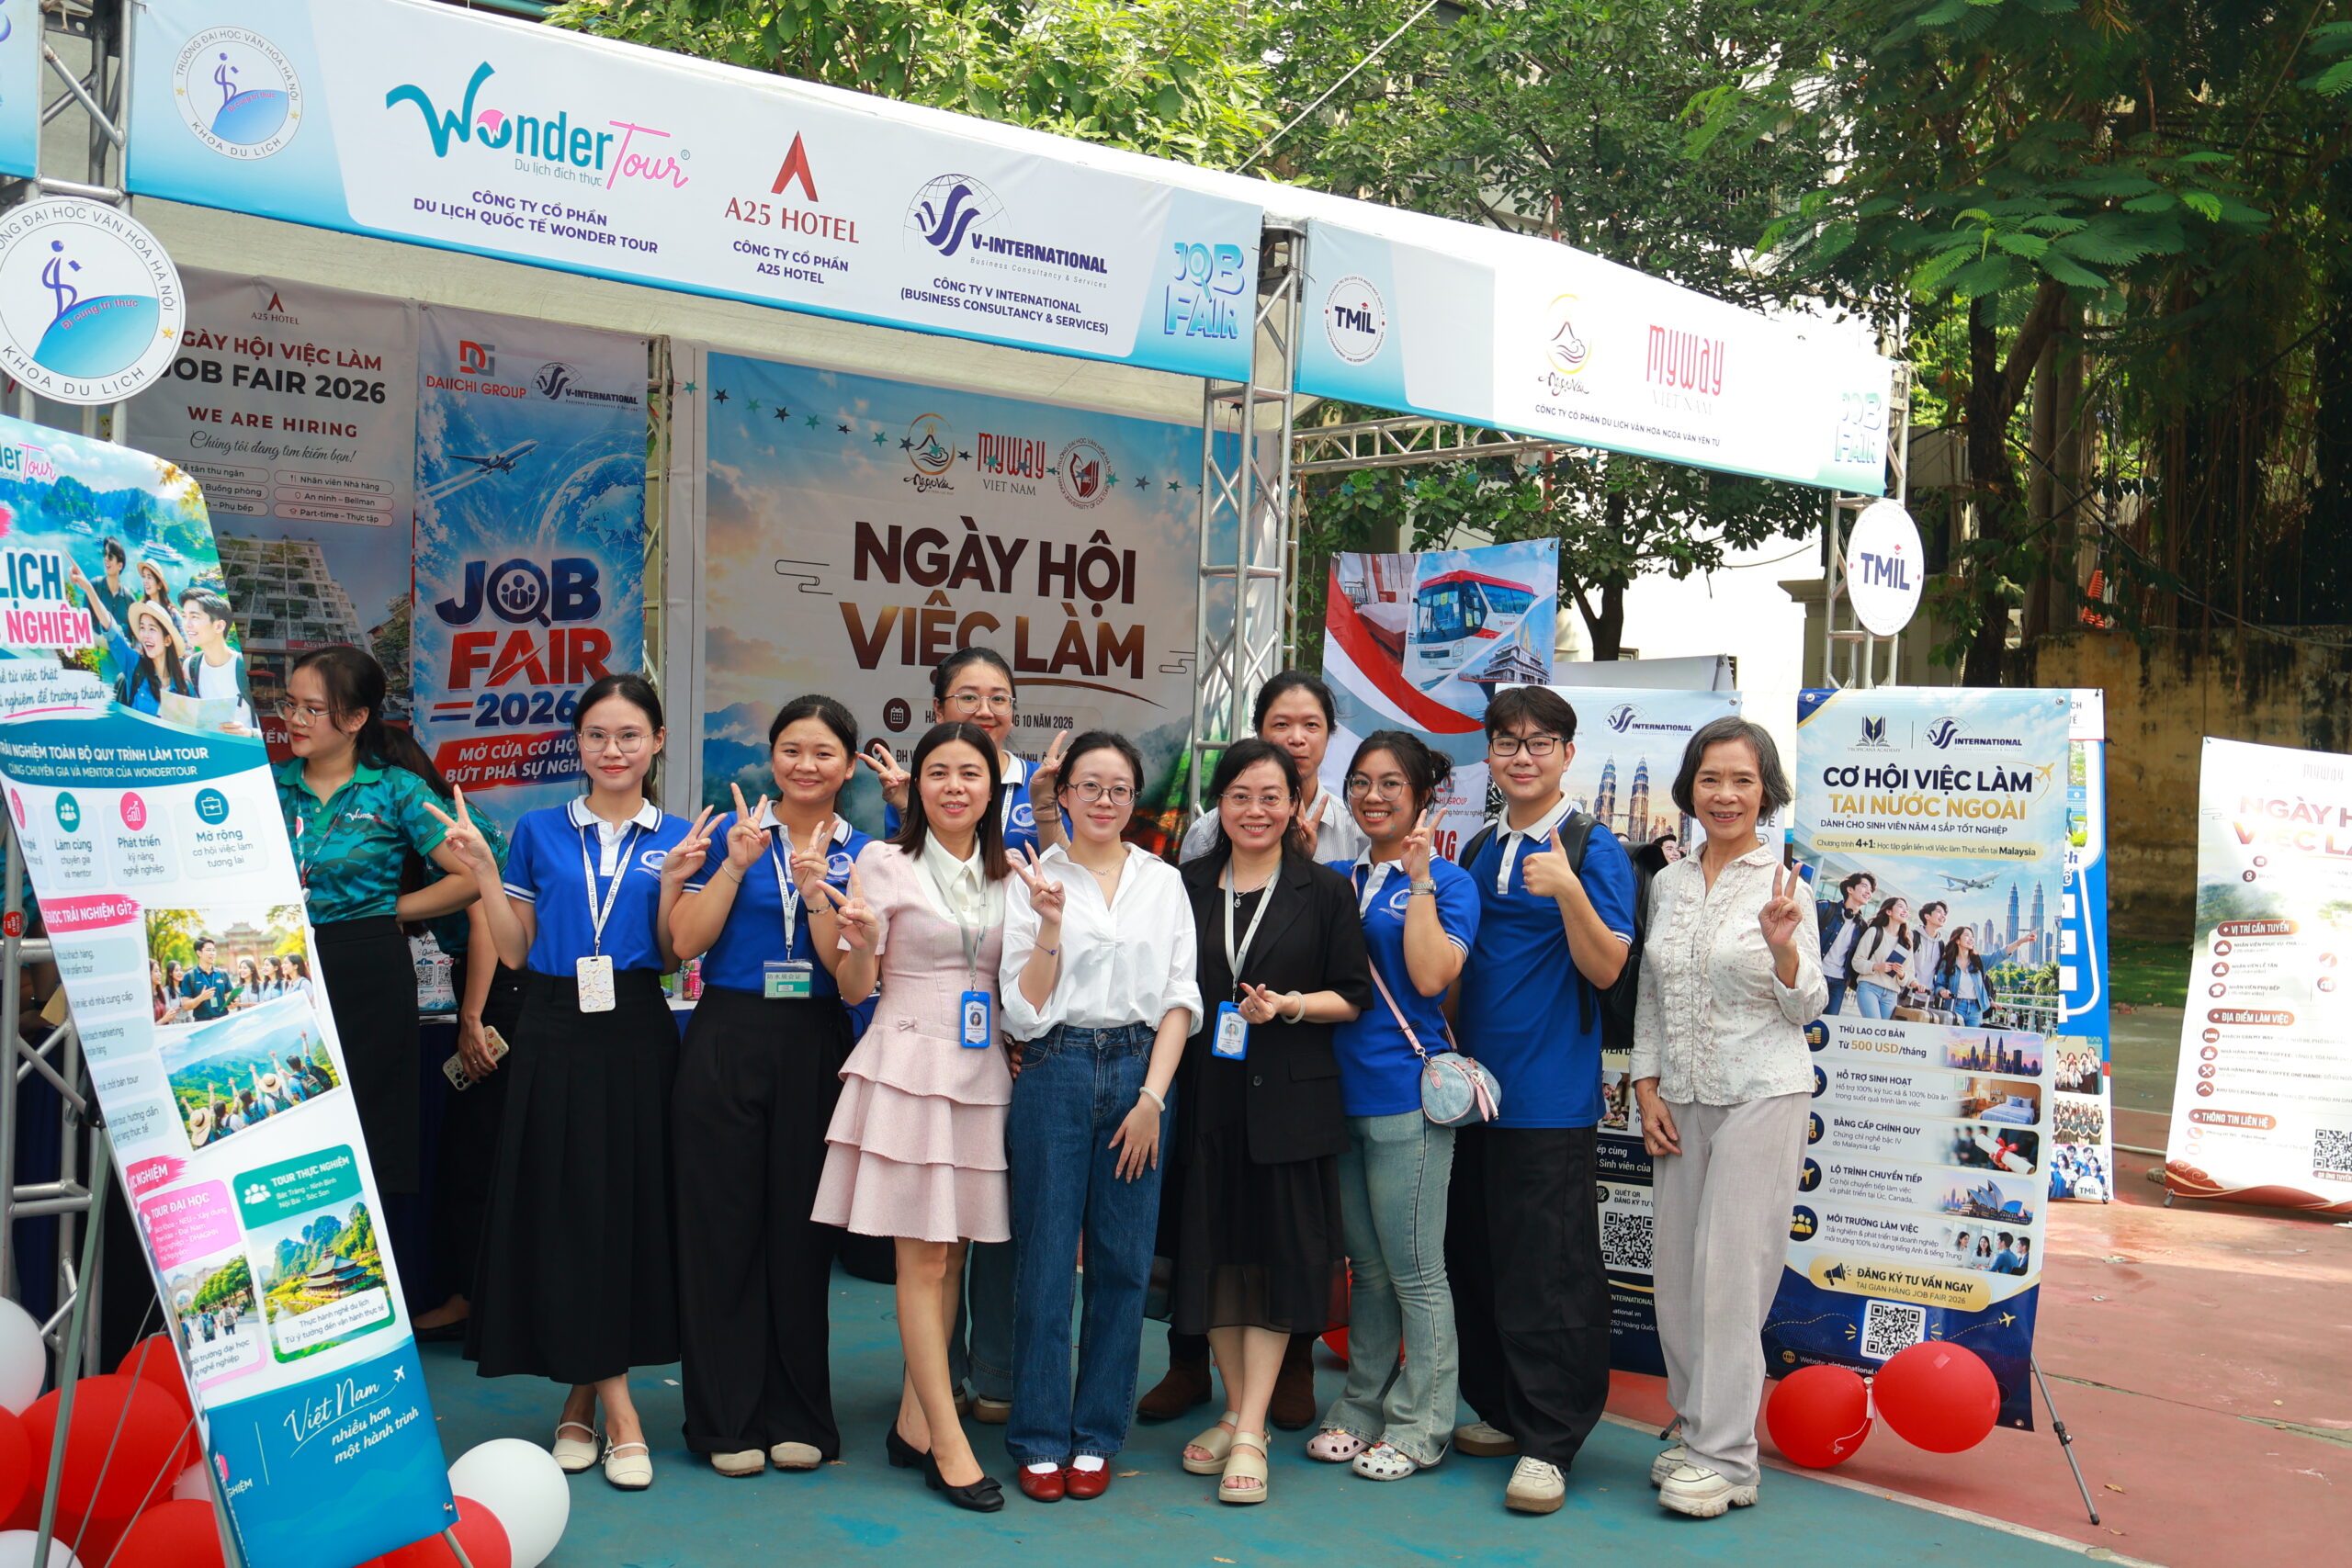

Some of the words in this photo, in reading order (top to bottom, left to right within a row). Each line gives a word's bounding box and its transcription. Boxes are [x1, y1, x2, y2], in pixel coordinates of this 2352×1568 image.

[514, 158, 529, 173] Du
[532, 162, 551, 178] lịch
[553, 165, 576, 181] đích
[579, 171, 603, 187] thực
[471, 189, 515, 209] CÔNG
[519, 197, 538, 213] TY
[541, 201, 562, 218] CỔ
[566, 209, 607, 227] PHẦN
[725, 197, 771, 226] A25
[781, 208, 860, 244] HOTEL
[413, 197, 436, 212] DU
[441, 201, 477, 220] LỊCH
[481, 208, 525, 229] QUỐC
[528, 218, 546, 232] TẾ
[550, 223, 616, 246] WONDER
[619, 236, 658, 254] TOUR
[21, 208, 50, 227] ĐẠI
[52, 206, 87, 221] HỌC
[92, 210, 125, 233] VĂN
[124, 229, 153, 260] HÓA
[150, 260, 166, 281] HÀ
[159, 284, 177, 312] NỘI
[733, 240, 770, 257] CÔNG
[774, 247, 789, 260] TY
[792, 250, 810, 264] CỔ
[813, 255, 849, 272] PHẦN
[971, 231, 1108, 275] V-INTERNATIONAL
[756, 262, 781, 276] A25
[784, 266, 825, 284] HOTEL
[969, 256, 1008, 270] Business
[1012, 264, 1062, 282] Consultancy
[1073, 276, 1108, 289] Services
[1173, 242, 1245, 300] JOB
[74, 305, 100, 322] cùng
[114, 299, 139, 309] thức
[900, 288, 961, 309] (BUSINESS
[963, 299, 1044, 322] CONSULTANCY
[1046, 313, 1054, 324] &
[1056, 314, 1109, 335] SERVICES)
[933, 276, 967, 294] CÔNG
[968, 283, 983, 296] TY
[985, 287, 994, 298] V
[995, 288, 1082, 314] INTERNATIONAL
[1164, 283, 1241, 339] FAIR
[251, 311, 268, 321] A25
[271, 313, 300, 325] HOTEL
[1334, 305, 1376, 334] TMIL
[182, 329, 228, 351] GÀY
[233, 335, 274, 360] HỘI
[280, 343, 331, 367] VIỆC
[336, 348, 382, 371] LÀM
[3, 345, 52, 388] KHOA
[63, 382, 90, 396] DU
[101, 367, 145, 395] LỊCH
[232, 364, 307, 395] FAIR
[315, 375, 386, 404] 2026
[426, 375, 477, 394] DAIICHI
[481, 382, 526, 400] GROUP
[565, 388, 639, 405] V-INTERNATIONAL
[187, 406, 222, 423] WE
[230, 412, 274, 429] ARE
[282, 417, 358, 438] HIRING
[189, 430, 235, 456] Chúng
[234, 438, 249, 453] tôi
[251, 437, 281, 460] đang
[301, 444, 330, 460] kiếm
[329, 449, 357, 464] bạn!
[983, 479, 1009, 493] VIET
[1010, 480, 1036, 497] NAM
[854, 515, 1029, 594] NGÀY
[1037, 529, 1136, 618] HỘI
[1860, 552, 1911, 591] TMIL
[435, 558, 602, 628] JOB
[6, 603, 92, 653] NGHIỆM
[1013, 602, 1146, 680] LÀM
[447, 627, 613, 691] FAIR
[475, 690, 579, 728] 2026
[1023, 715, 1032, 728] 10
[1033, 713, 1052, 729] NĂM
[1053, 716, 1074, 729] 2026
[458, 741, 488, 761] MỞ
[491, 739, 524, 758] CỬA
[527, 739, 552, 756] CƠ
[1954, 737, 2023, 747] INTERNATIONAL
[445, 763, 481, 783] BỨT
[483, 762, 516, 780] PHÁ
[521, 761, 545, 778] SỰ
[1823, 765, 1860, 788] CƠ
[1864, 762, 1909, 795] HỘI
[1914, 764, 1973, 796] VIỆC
[1977, 765, 2033, 793] LÀM
[1828, 794, 1865, 819] TẠI
[1870, 790, 1941, 818] NƯỚC
[1946, 794, 2026, 820] NGOÀI
[1820, 818, 1845, 829] DÀNH
[1846, 820, 1865, 829] CHO
[1866, 821, 1886, 830] SINH
[1887, 821, 1907, 831] VIÊN
[1908, 821, 1928, 832] NĂM
[1930, 824, 1937, 832] 4
[1938, 822, 1955, 833] SẮP
[1956, 822, 1973, 834] TỐT
[1974, 824, 2008, 837] NGHIỆP
[1999, 846, 2037, 857] Malaysia
[2231, 925, 2239, 936] VỊ
[2240, 923, 2251, 934] TRÍ
[2267, 919, 2290, 933] TUYỂN
[1838, 1025, 1856, 1035] THÙ
[1856, 1027, 1873, 1036] LAO
[1873, 1027, 1888, 1037] CƠ
[1889, 1027, 1905, 1039] BẢN
[1838, 1040, 1849, 1051] Từ
[1850, 1040, 1873, 1053] 500
[1874, 1043, 1927, 1059] USD/tháng
[2201, 1111, 2226, 1123] THÔNG
[2227, 1114, 2241, 1124] TIN
[2241, 1115, 2258, 1126] LIÊN
[2258, 1117, 2269, 1129] HỆ
[270, 1172, 294, 1188] TOUR
[295, 1165, 320, 1183] THỰC
[319, 1156, 350, 1175] NGHIỆM
[1599, 1158, 1617, 1169] Sinh
[1617, 1160, 1634, 1171] viên
[1635, 1161, 1652, 1173] của
[1857, 1267, 1886, 1282] ĐĂNG
[1888, 1269, 1904, 1283] KÝ
[1905, 1271, 1923, 1285] TƯ
[1922, 1272, 1943, 1290] VẤN
[1945, 1280, 1973, 1294] NGAY
[283, 1397, 334, 1443] Việt
[336, 1378, 380, 1416] Nam
[332, 1419, 368, 1446] nhiều
[369, 1405, 391, 1427] hơn
[334, 1445, 361, 1465] một
[364, 1425, 394, 1448] hành
[395, 1406, 420, 1431] trình
